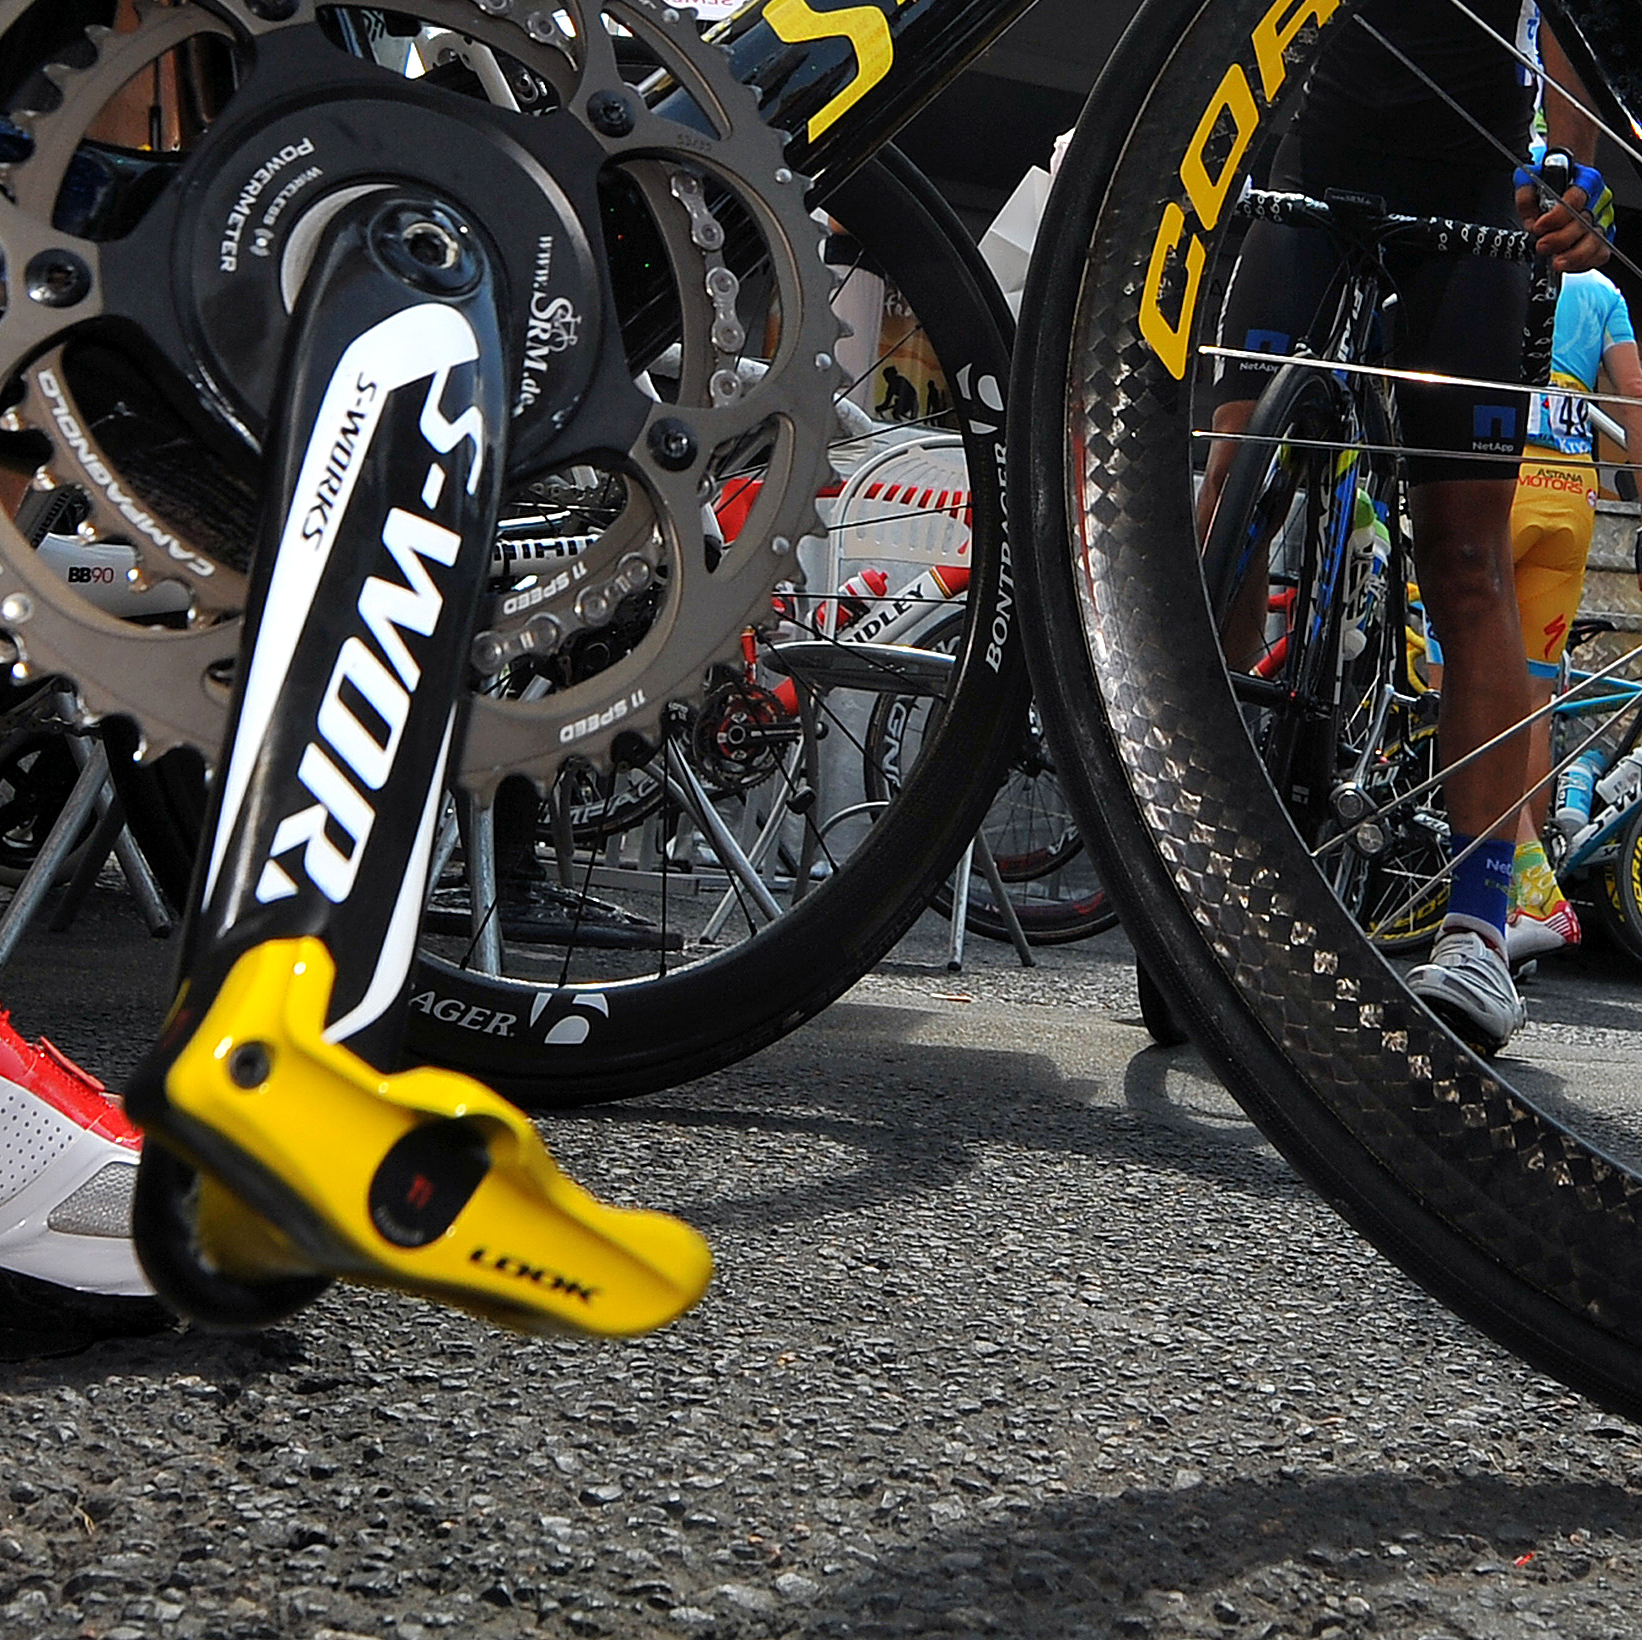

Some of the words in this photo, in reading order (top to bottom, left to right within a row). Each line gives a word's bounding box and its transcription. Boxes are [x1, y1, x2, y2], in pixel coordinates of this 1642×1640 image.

[218, 136, 314, 274] POWERMETER
[301, 369, 375, 556] S-WORKS
[1471, 440, 1515, 454] NetApp
[38, 369, 216, 579] CAMPAGNOLO
[1518, 475, 1584, 494] MOTORS
[1535, 467, 1584, 484] ASTANA
[67, 565, 115, 587] BB90
[502, 570, 570, 616] SPEED
[559, 695, 629, 742] SPEED
[466, 1246, 602, 1305] LOOK
